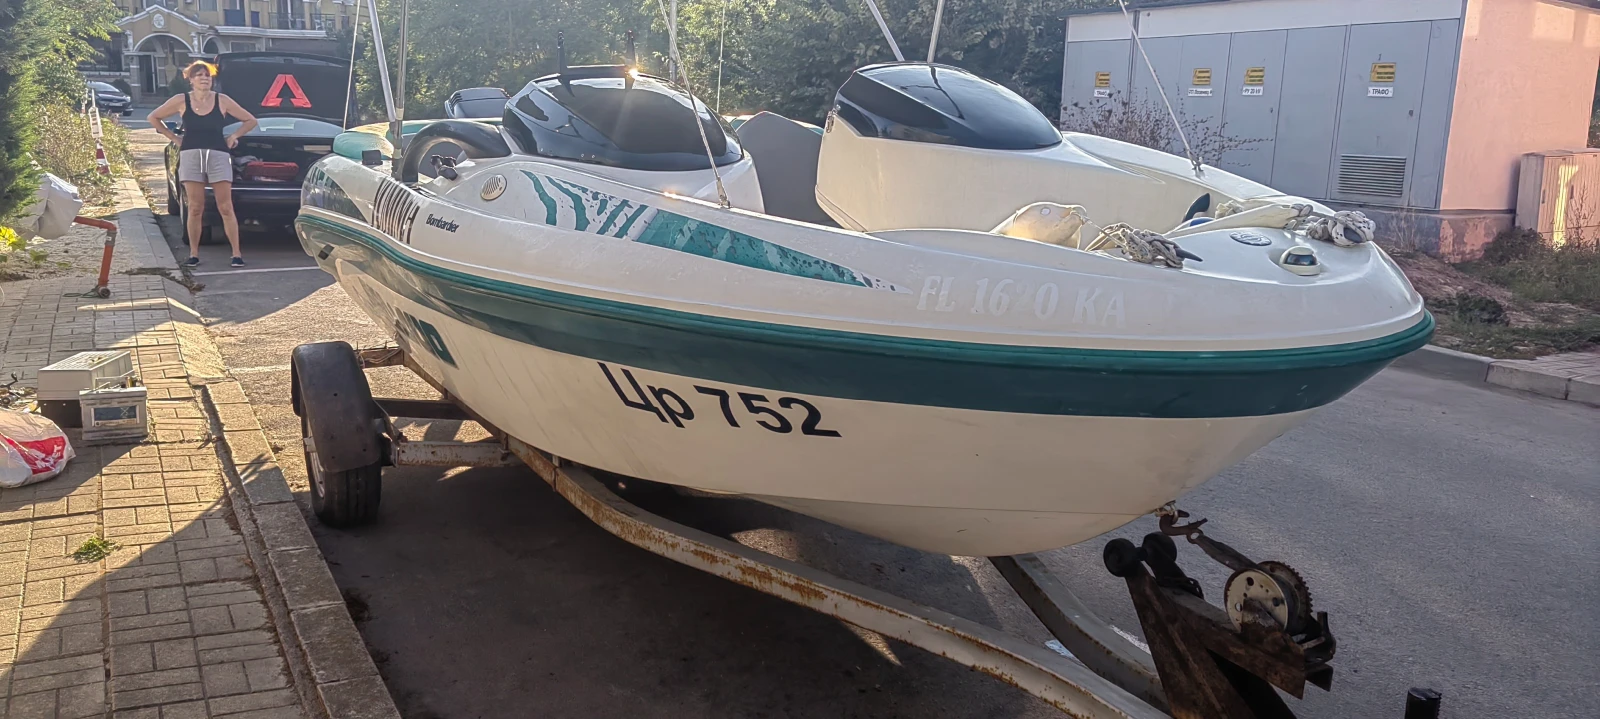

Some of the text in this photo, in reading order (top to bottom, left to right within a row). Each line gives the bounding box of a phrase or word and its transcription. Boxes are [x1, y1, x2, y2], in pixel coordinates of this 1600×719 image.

[426, 213, 460, 233] Bombardier
[916, 275, 956, 313] FL
[1072, 286, 1127, 329] KA
[597, 361, 842, 438] Цр 752
